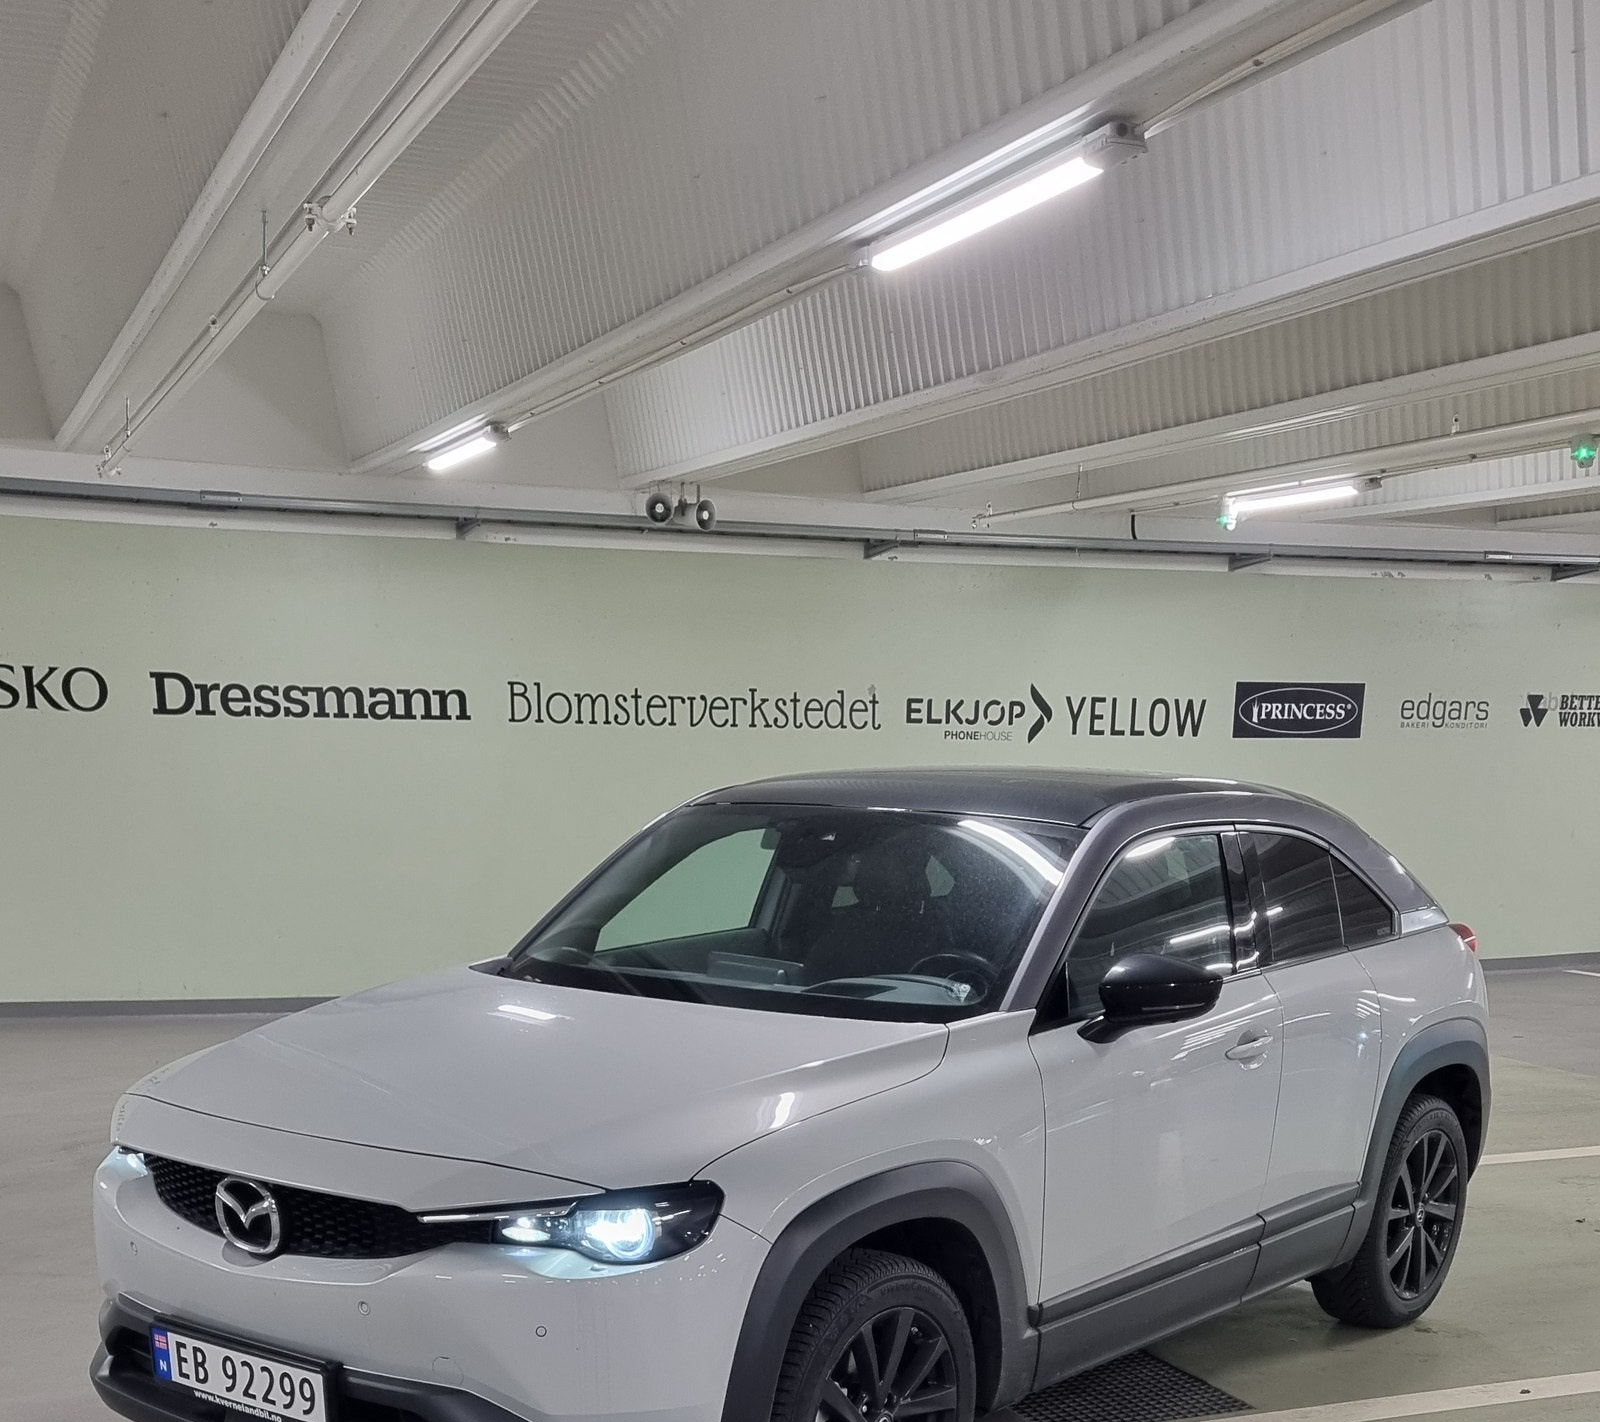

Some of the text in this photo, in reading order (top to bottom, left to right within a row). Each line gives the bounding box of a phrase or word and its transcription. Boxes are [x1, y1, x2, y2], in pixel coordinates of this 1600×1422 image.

[0, 664, 109, 712] SKO
[149, 671, 472, 721] Dressmann
[507, 681, 882, 730] Blomsterverkstedet
[1065, 695, 1207, 737] YELLOW
[1260, 702, 1346, 720] PRINCESS
[1400, 692, 1490, 728] edgars
[1400, 721, 1430, 729] BAKERI
[1558, 711, 1600, 727] WORK
[159, 1359, 168, 1373] N
[175, 1340, 316, 1415] EB 92299
